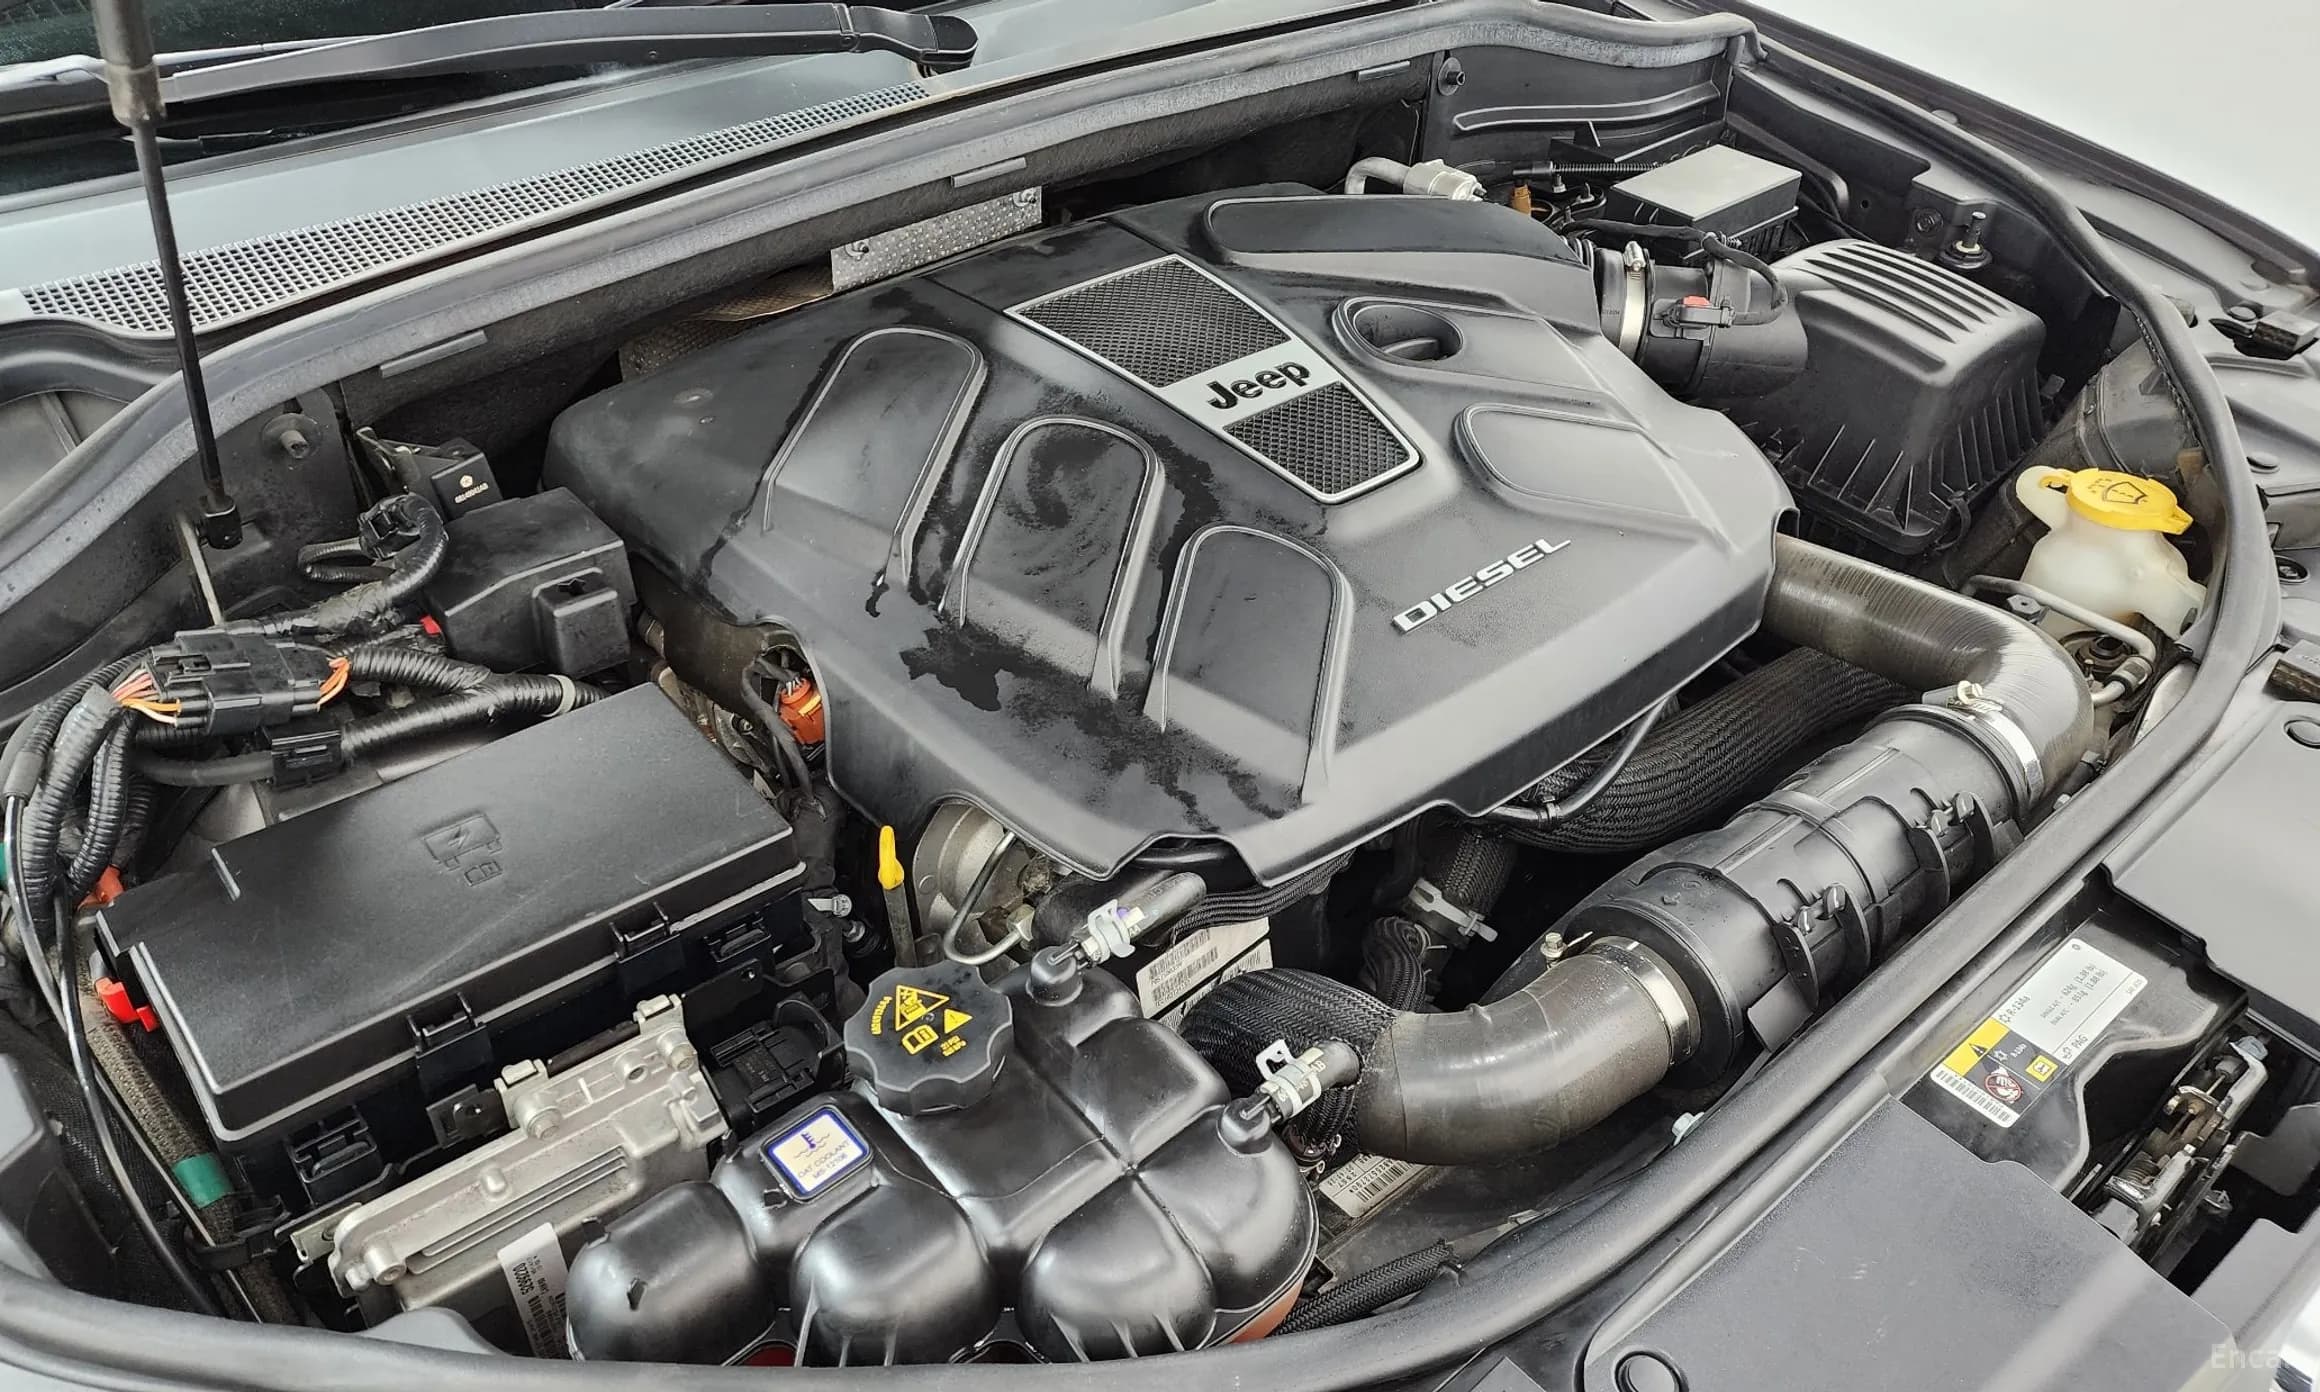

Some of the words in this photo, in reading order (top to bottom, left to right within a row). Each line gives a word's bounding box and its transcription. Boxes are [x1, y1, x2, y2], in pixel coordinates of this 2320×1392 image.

[1206, 361, 1311, 410] Jeep
[1391, 538, 1571, 634] DIESEL
[814, 1139, 850, 1167] COOLANT
